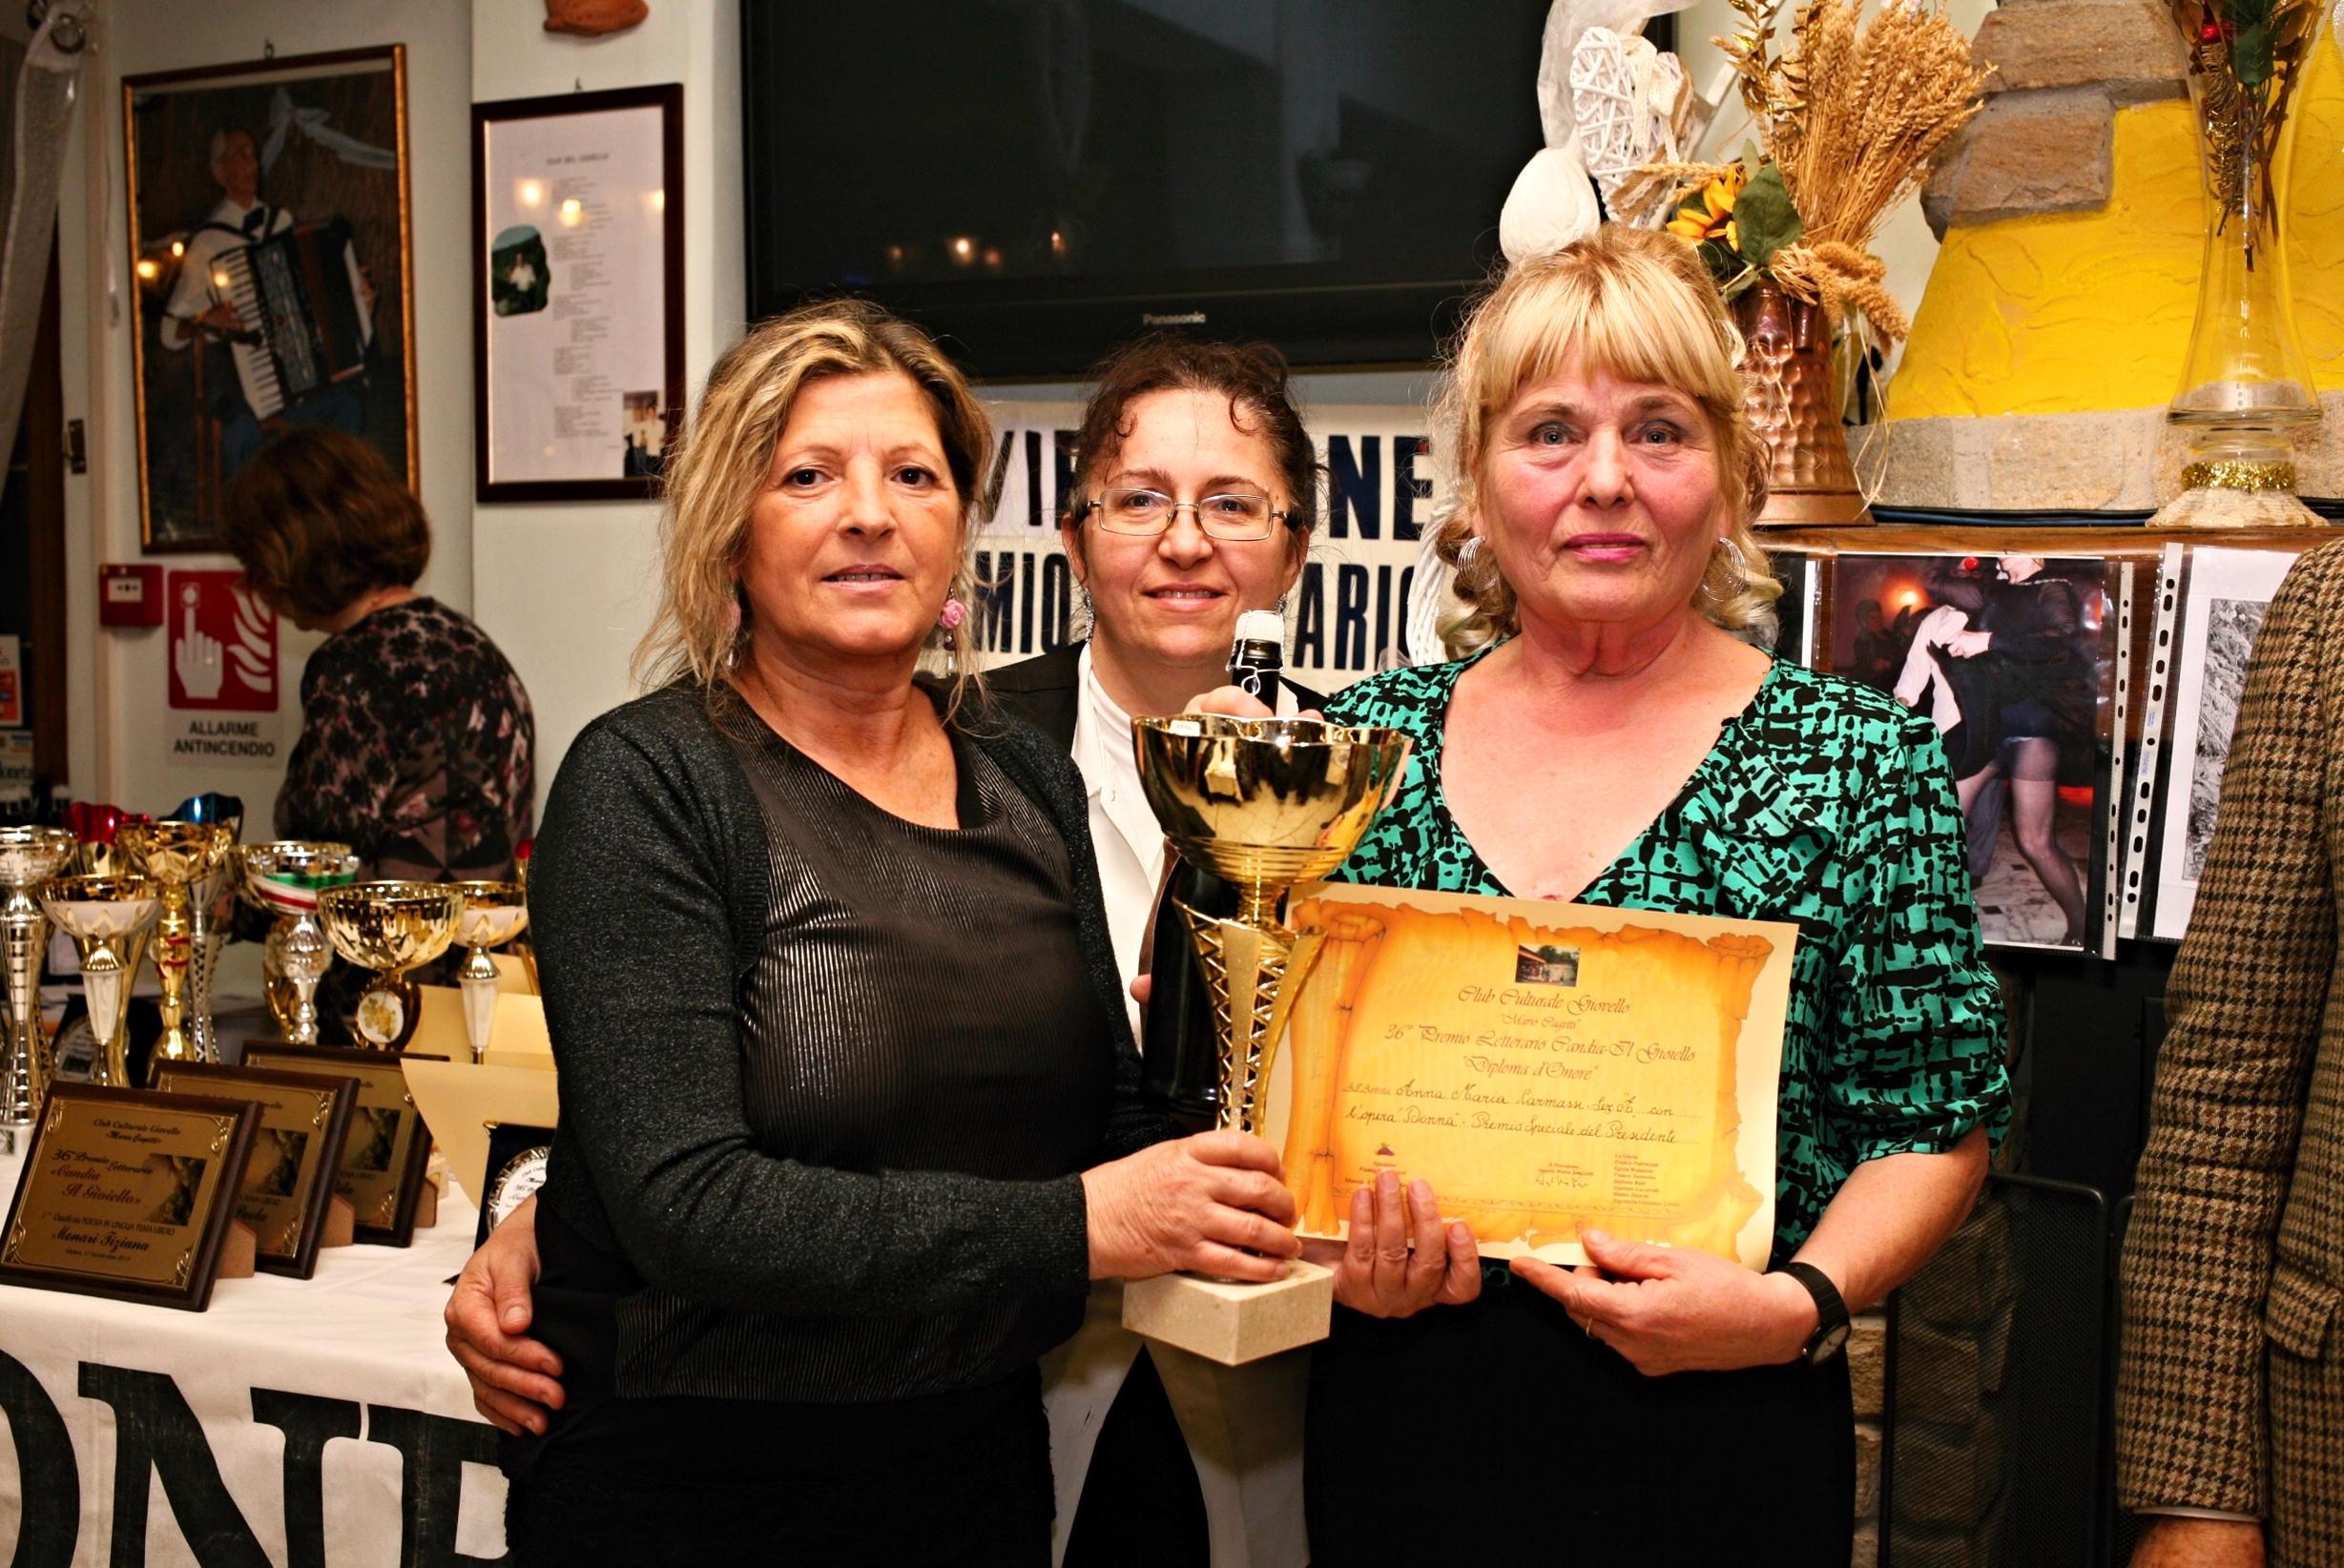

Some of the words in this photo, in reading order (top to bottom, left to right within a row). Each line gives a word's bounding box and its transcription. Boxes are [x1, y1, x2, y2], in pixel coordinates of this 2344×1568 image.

[1142, 312, 1207, 325] Panasonic
[1292, 563, 1417, 671] ARI
[189, 720, 259, 738] ALLARME
[174, 738, 276, 757] ANTINCENDIO
[1458, 985, 1496, 1002] Club
[1500, 989, 1564, 1009] Culturale
[1566, 995, 1630, 1016] Giovello
[1419, 1024, 1471, 1045] Premio
[1475, 1030, 1546, 1051] Letterario
[1635, 1042, 1695, 1064] Gioiello
[1396, 1079, 1444, 1100] Anna
[1450, 1083, 1508, 1104] Maria
[1471, 1111, 1522, 1132] Premio
[1577, 1124, 1600, 1138] del
[1605, 1120, 1677, 1144] Presidente
